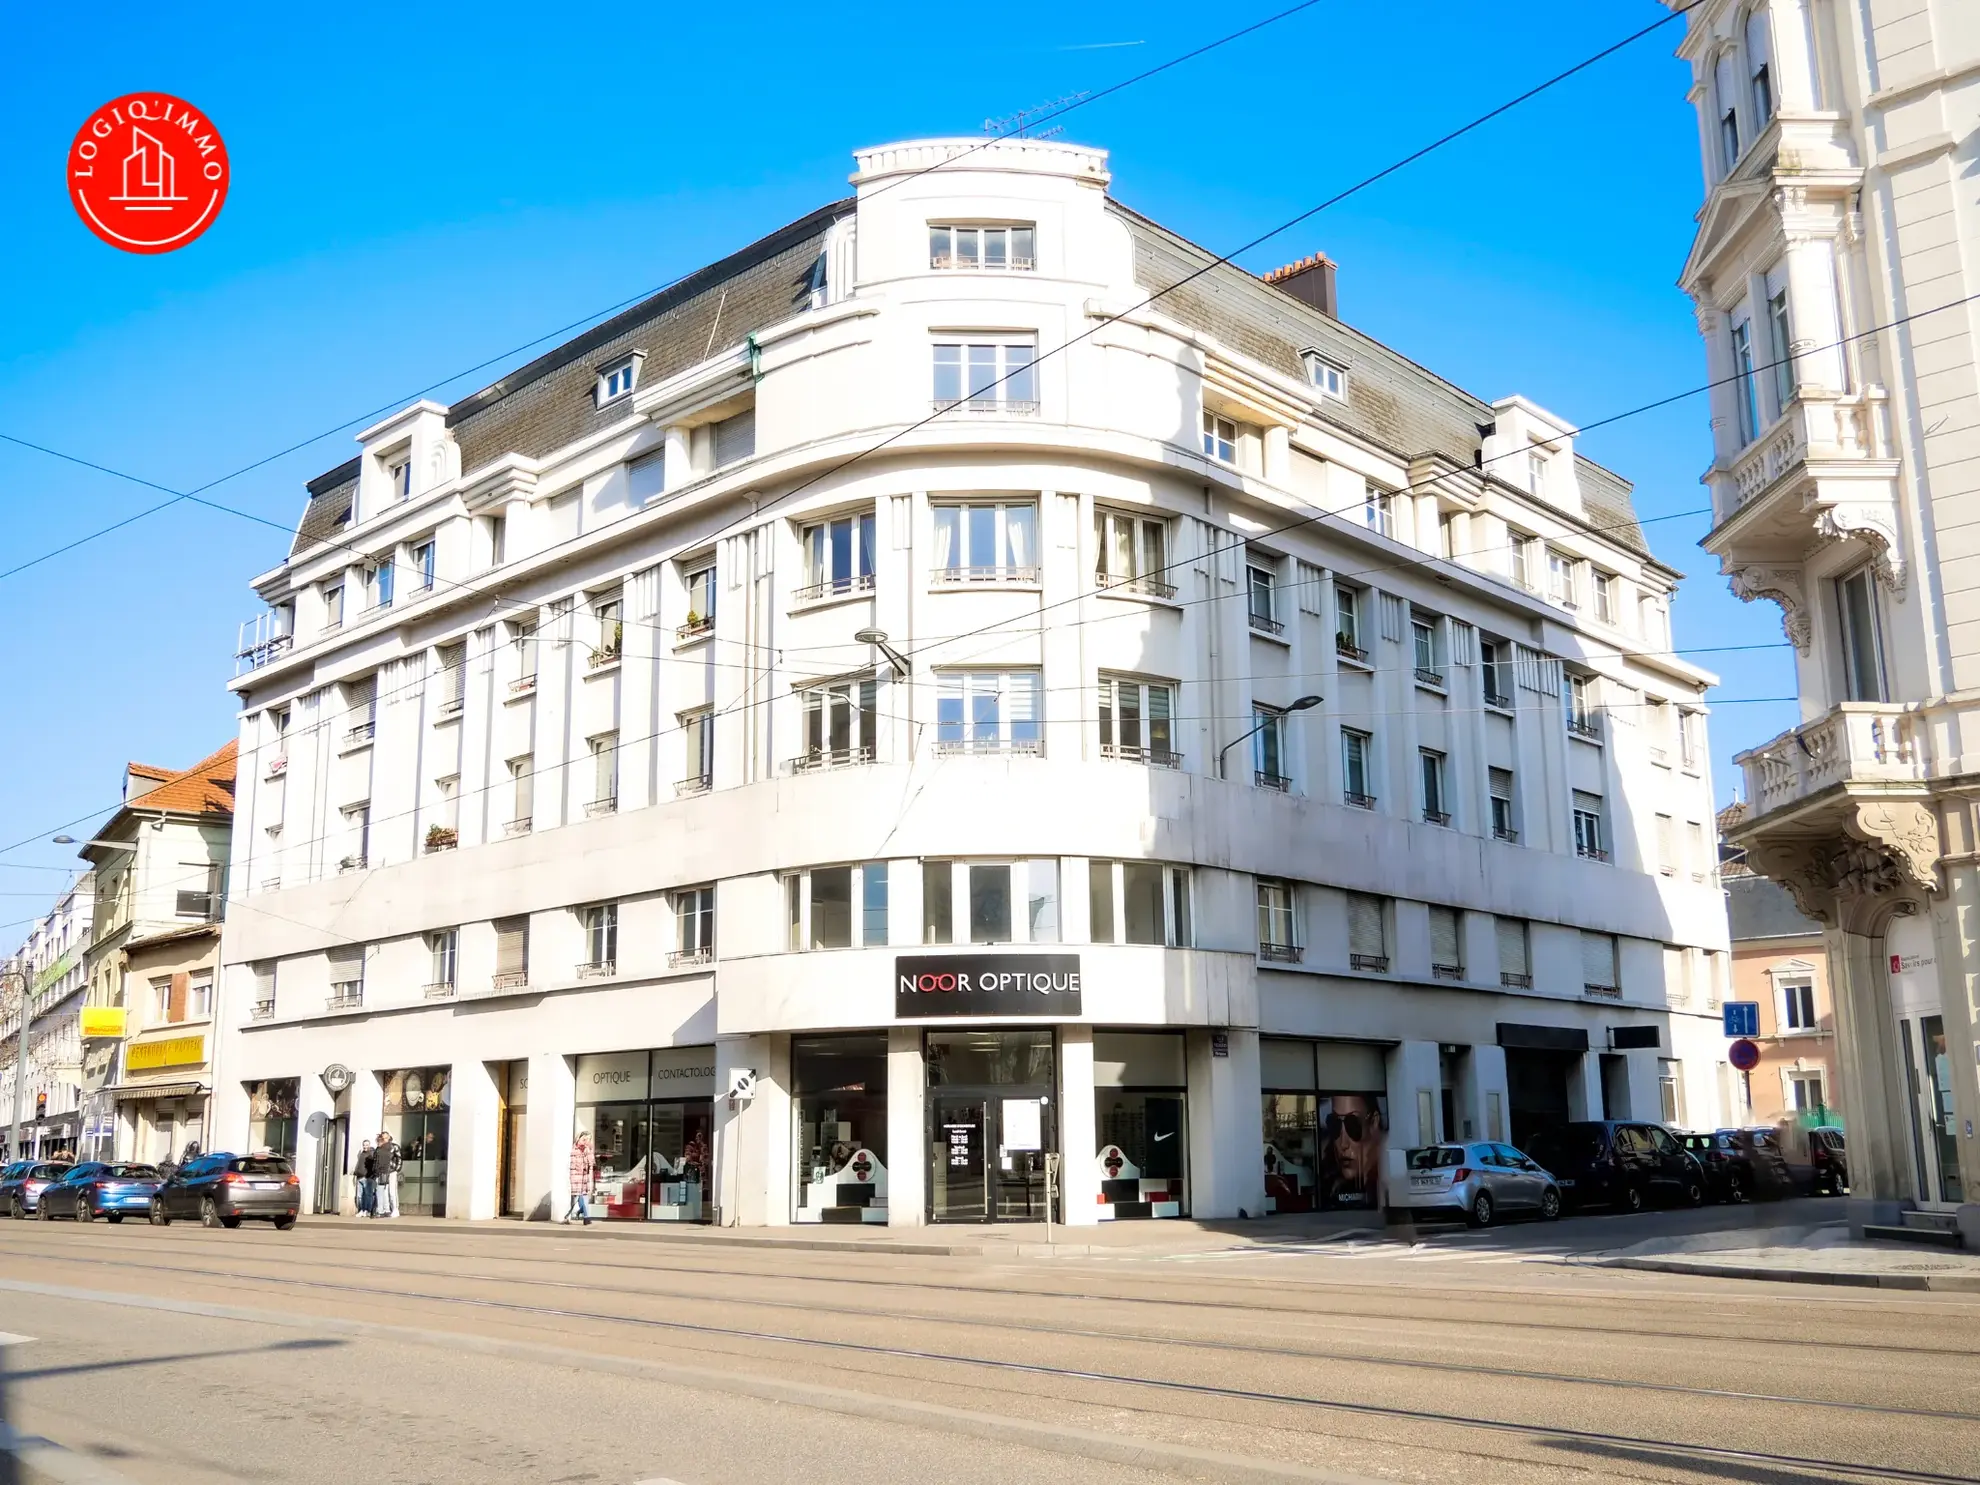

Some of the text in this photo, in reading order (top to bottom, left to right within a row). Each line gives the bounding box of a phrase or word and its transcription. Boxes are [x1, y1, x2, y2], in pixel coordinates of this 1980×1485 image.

[900, 972, 1080, 995] NOOR OPTIQUE
[593, 1070, 632, 1085] OPTIQUE
[658, 1066, 716, 1080] CONTACTOLOG
